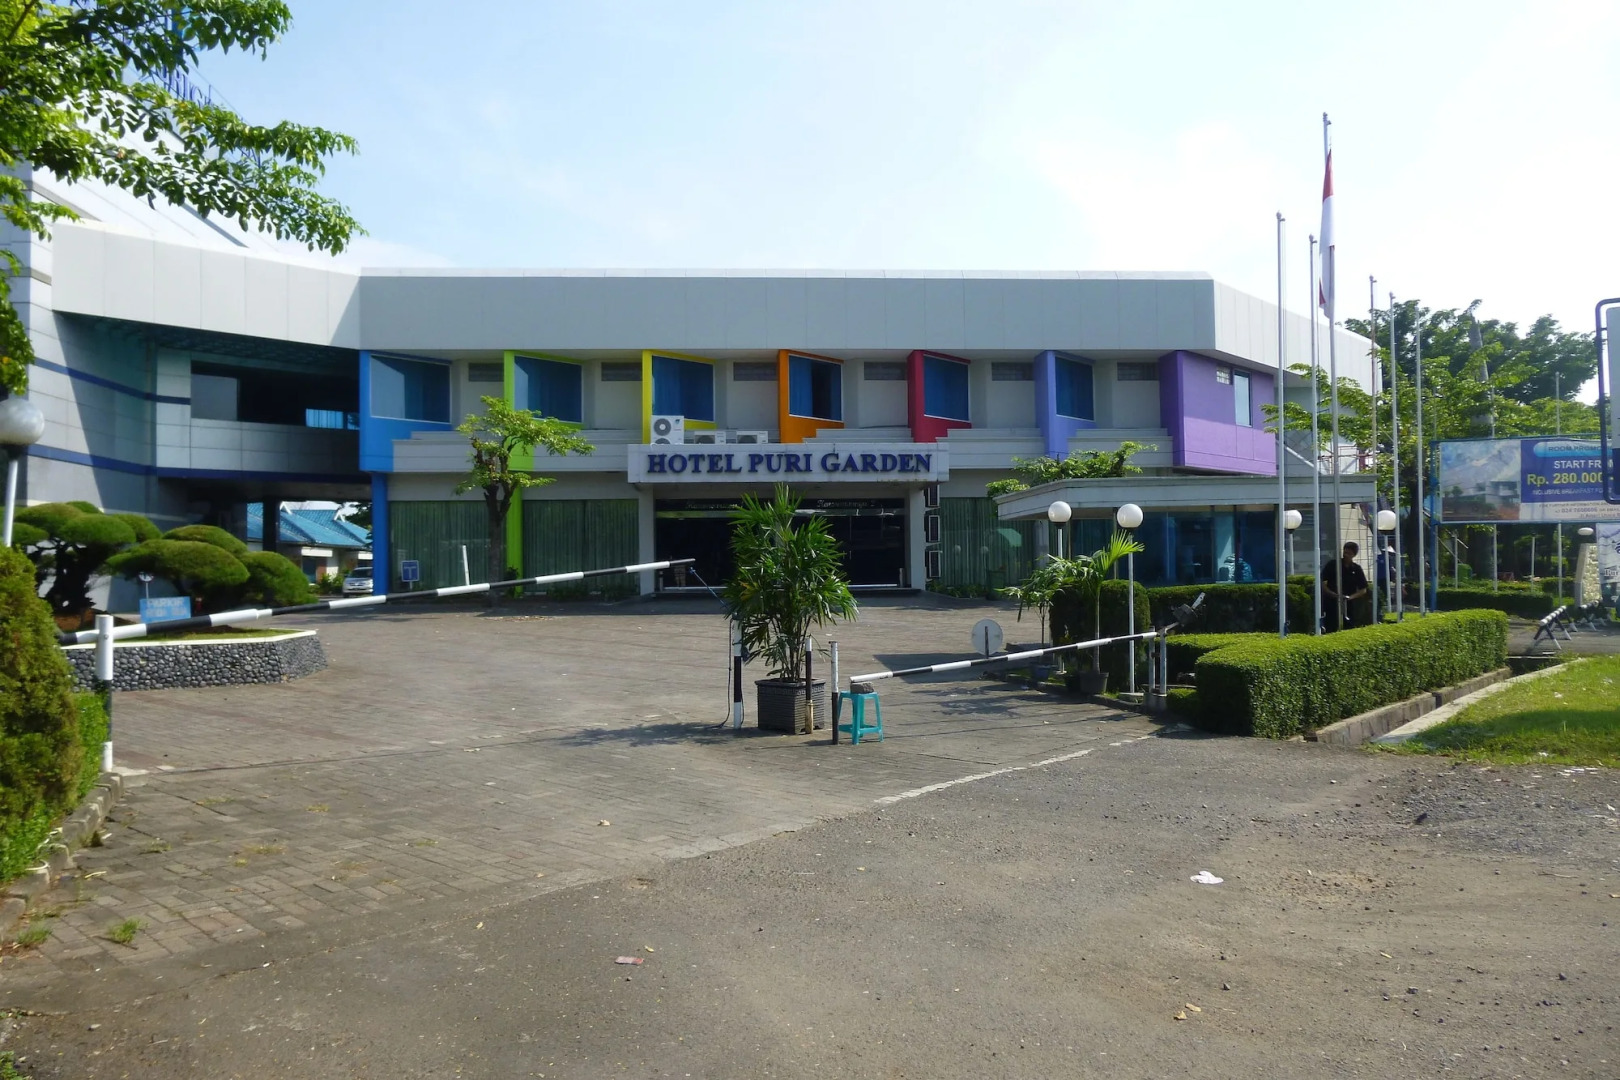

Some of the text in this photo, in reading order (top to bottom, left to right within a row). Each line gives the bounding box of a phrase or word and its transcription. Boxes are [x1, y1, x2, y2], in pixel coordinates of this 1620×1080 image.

[647, 452, 932, 474] HOTEL PURI GARDEN
[1554, 459, 1614, 469] START FRM
[1527, 473, 1549, 487] Rp.
